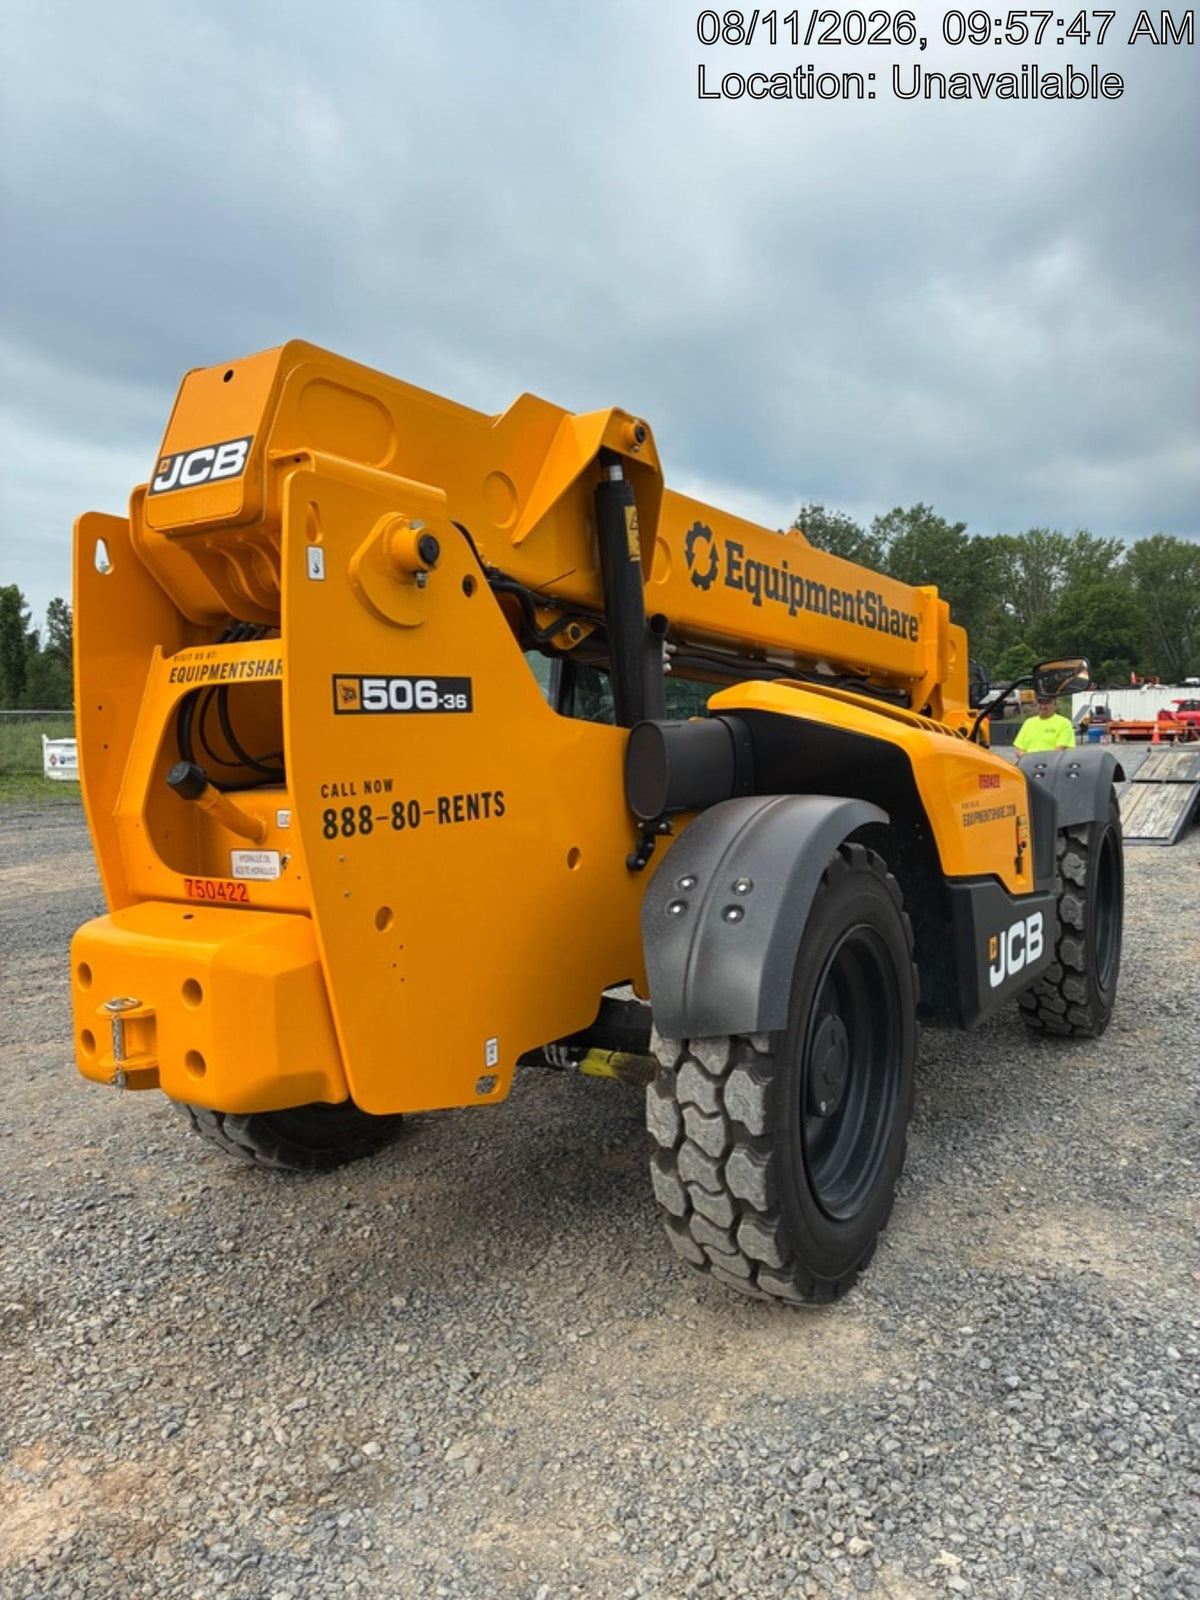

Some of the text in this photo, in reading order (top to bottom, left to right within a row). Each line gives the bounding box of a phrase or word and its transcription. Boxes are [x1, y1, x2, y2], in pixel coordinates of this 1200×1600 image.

[153, 440, 248, 491] JCB
[724, 539, 918, 642] EquipmentShare
[320, 779, 394, 798] CALL NOW
[323, 791, 506, 840] 888-80-RENTS
[184, 878, 249, 902] 750422
[990, 911, 1043, 988] JCB
